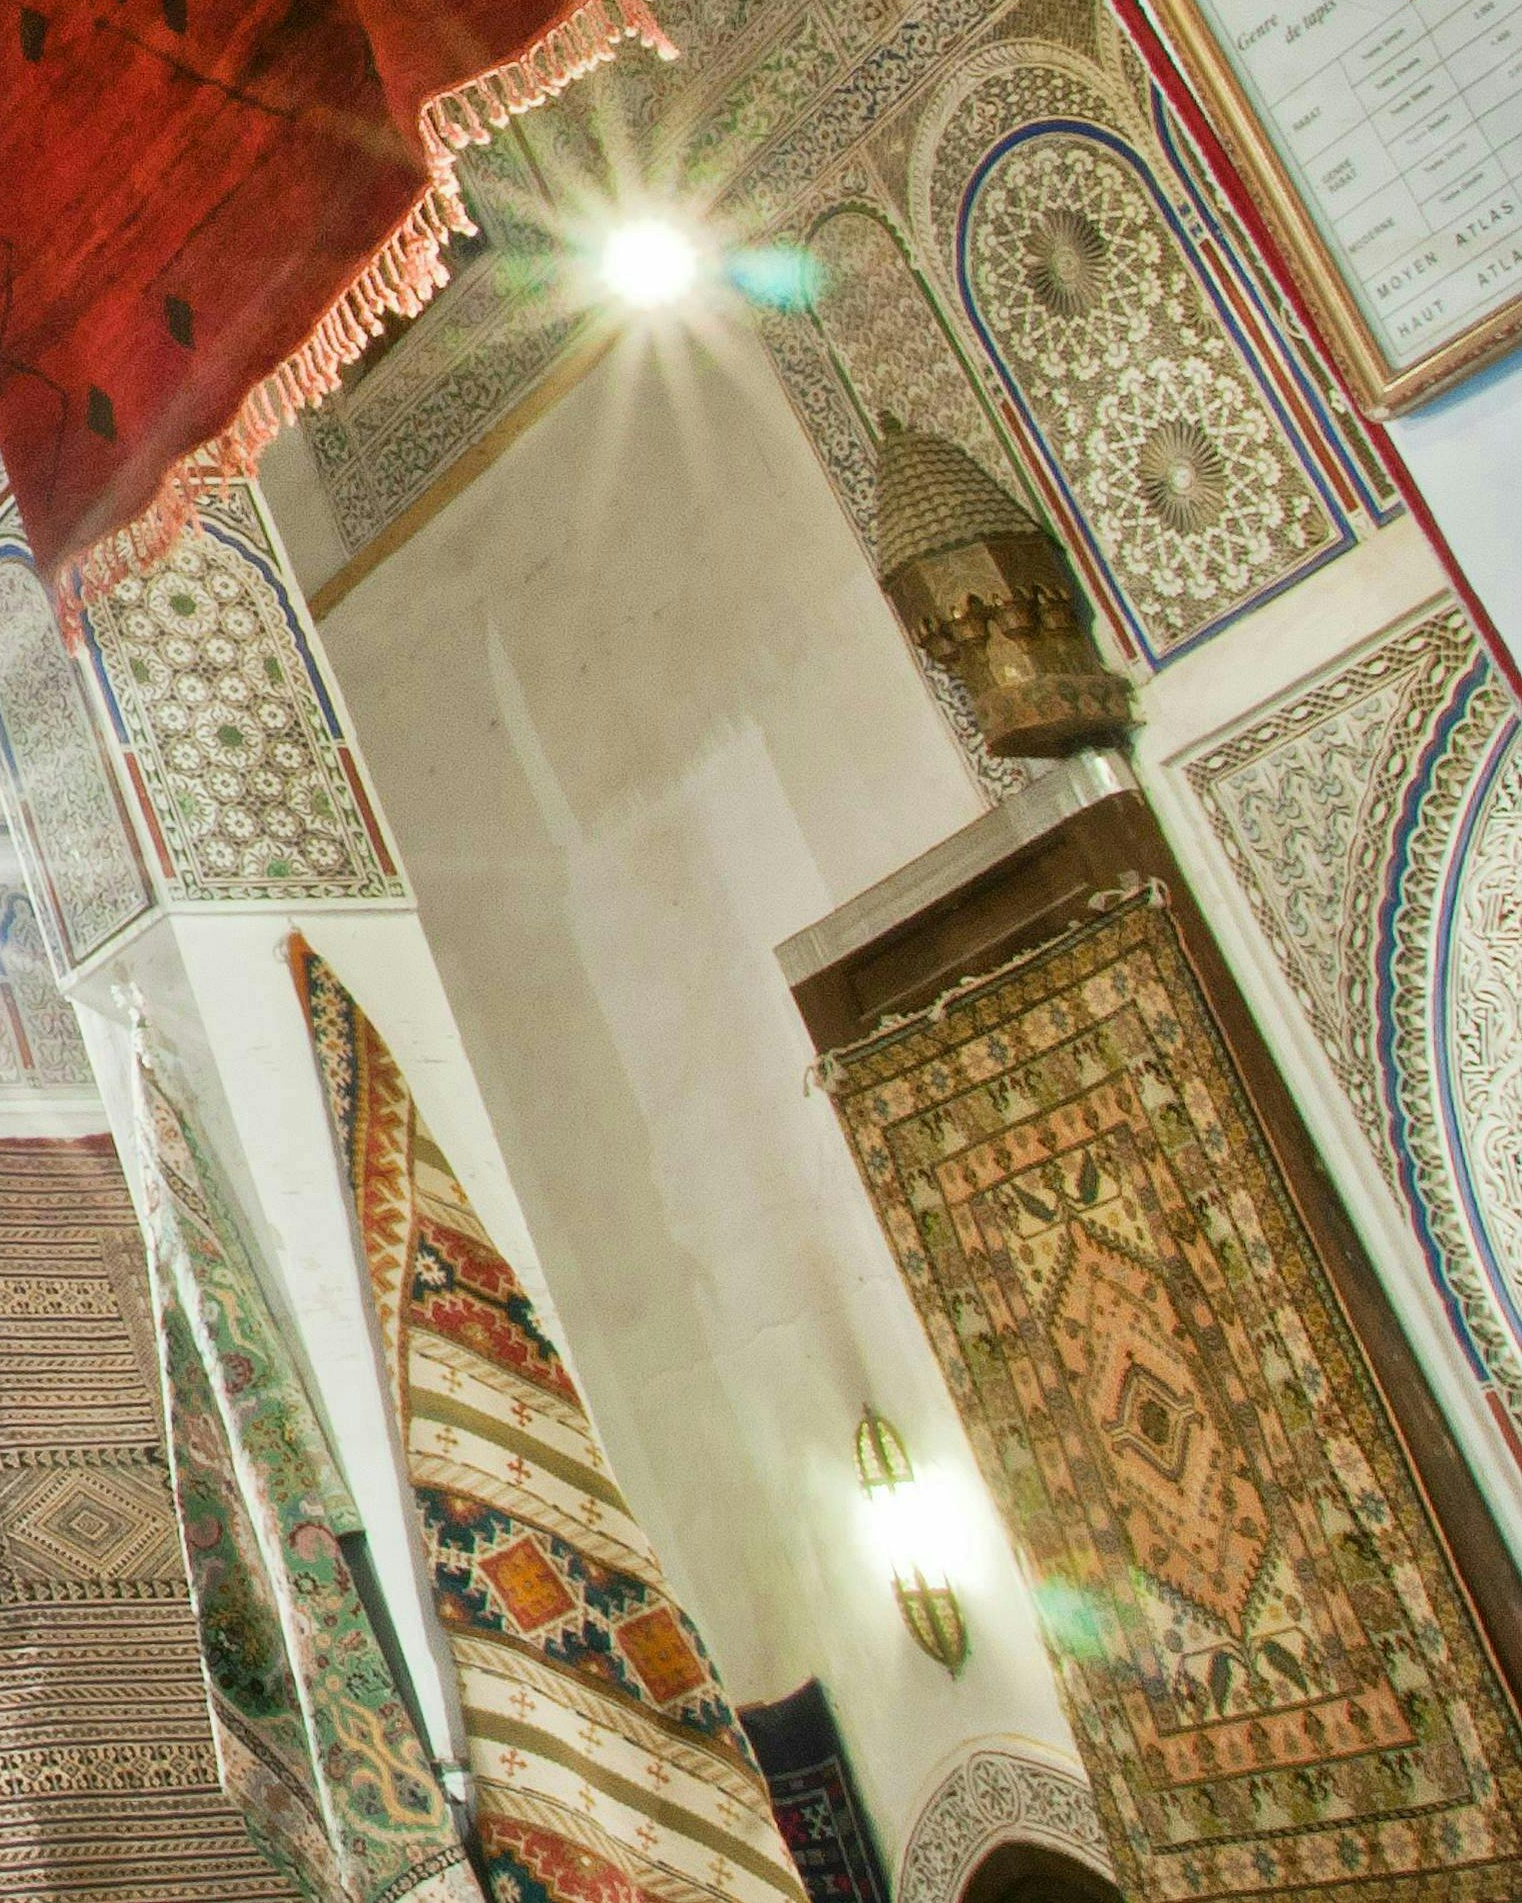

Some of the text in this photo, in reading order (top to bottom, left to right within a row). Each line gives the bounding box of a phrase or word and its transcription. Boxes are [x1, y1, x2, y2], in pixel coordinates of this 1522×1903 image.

[1237, 14, 1279, 50] Genre
[1285, 25, 1301, 44] de
[1376, 199, 1514, 299] MOYEN ATLAS
[1397, 299, 1444, 338] HAUT
